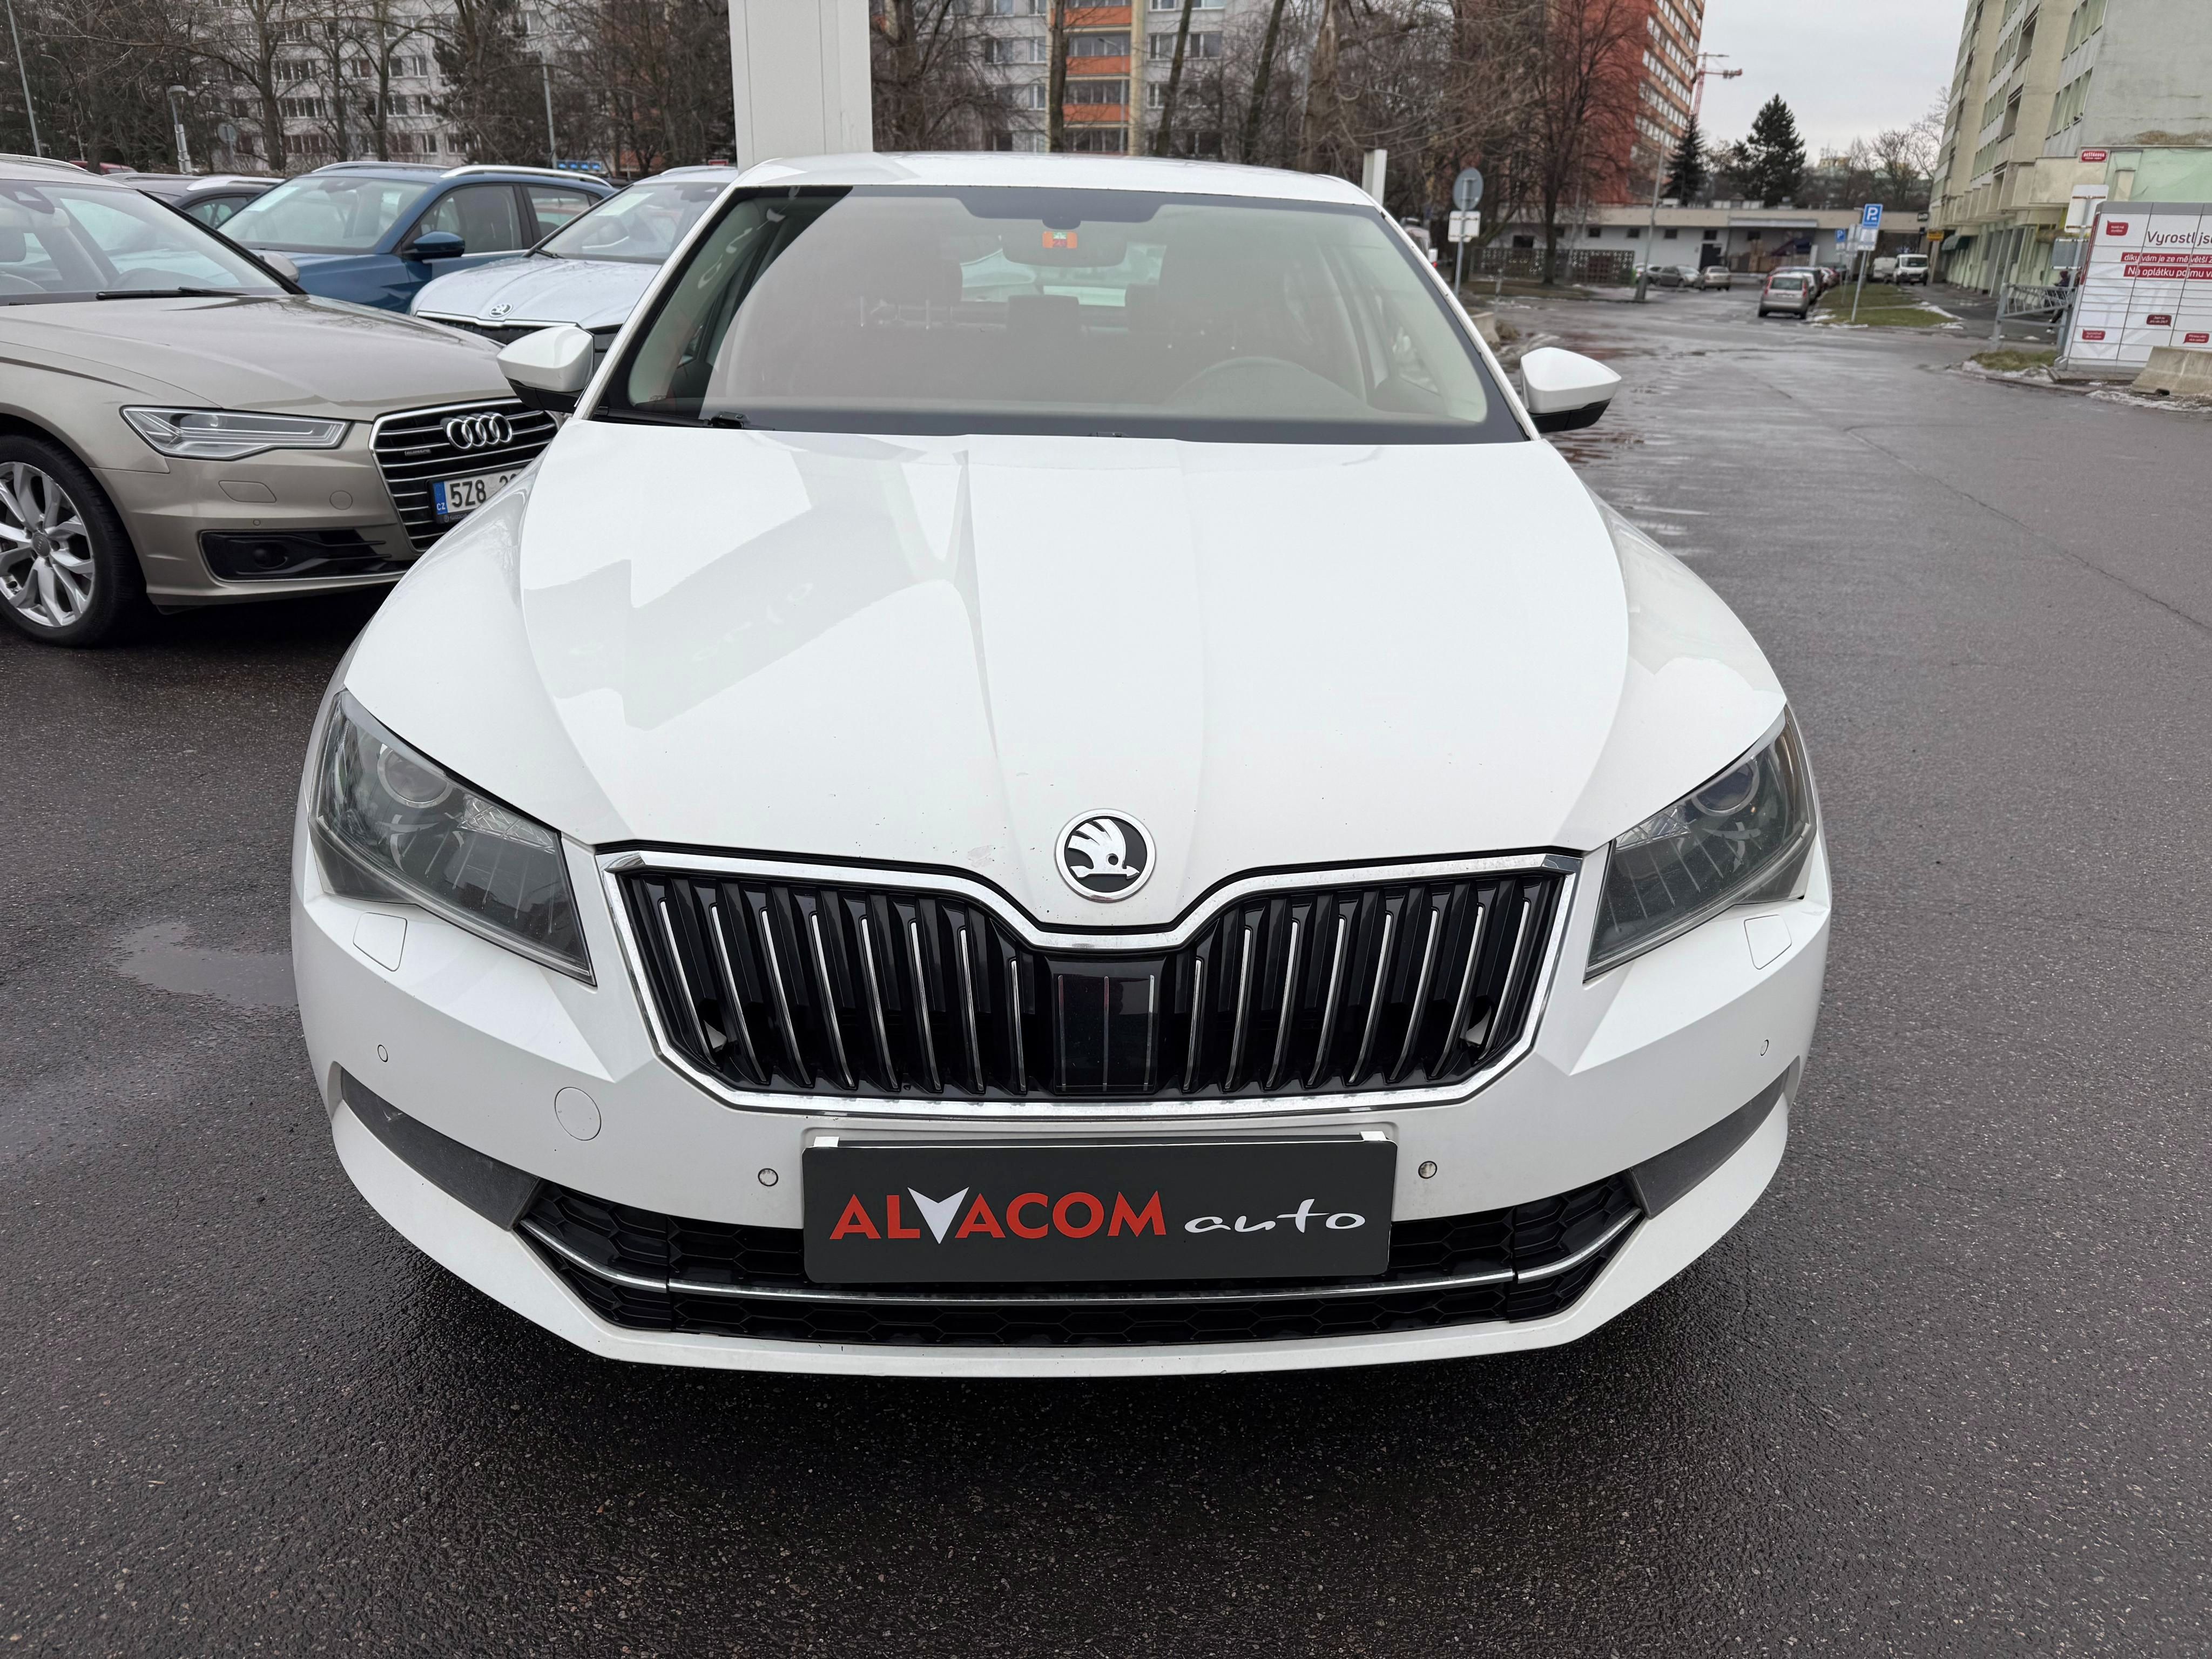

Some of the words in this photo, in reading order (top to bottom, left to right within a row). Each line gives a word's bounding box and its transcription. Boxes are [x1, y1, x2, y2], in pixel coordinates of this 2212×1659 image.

[1866, 207, 1878, 221] P
[2148, 231, 2196, 246] Vyrostl
[2197, 232, 2212, 246] js
[2124, 254, 2140, 262] díky
[2157, 255, 2165, 263] je
[2128, 266, 2140, 275] Na
[2142, 267, 2174, 276] oplátku
[2176, 269, 2203, 278] pojmu
[450, 480, 486, 508] 5Z8
[830, 1187, 1166, 1244] ALVACOM
[1185, 1199, 1365, 1232] auto
